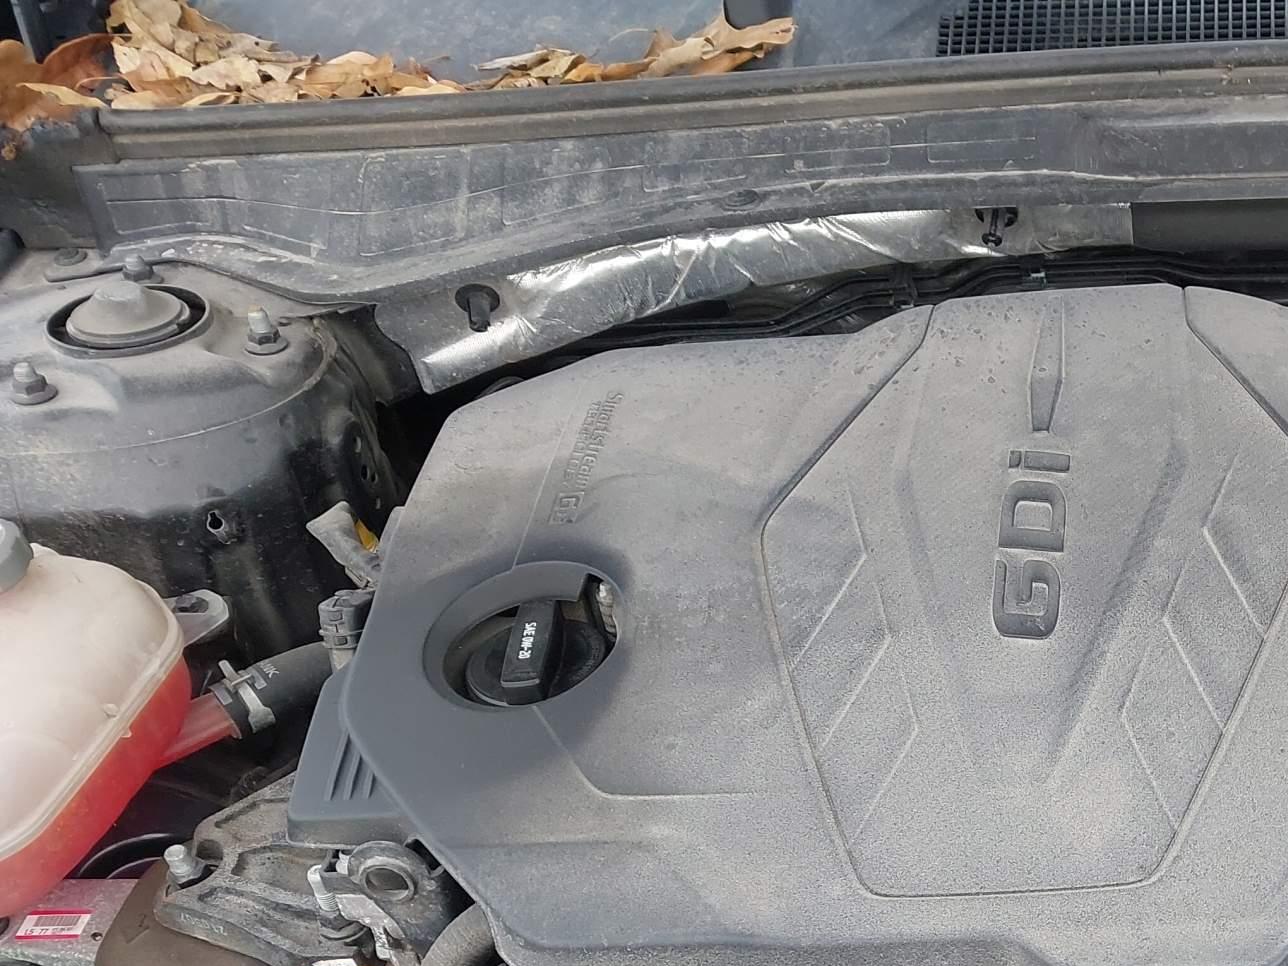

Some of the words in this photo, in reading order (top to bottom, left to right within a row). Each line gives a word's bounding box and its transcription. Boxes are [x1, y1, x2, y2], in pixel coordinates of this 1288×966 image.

[576, 391, 624, 490] Smartstream
[992, 450, 1070, 640] GDi
[518, 636, 534, 659] 0W-20
[523, 622, 537, 636] SAE
